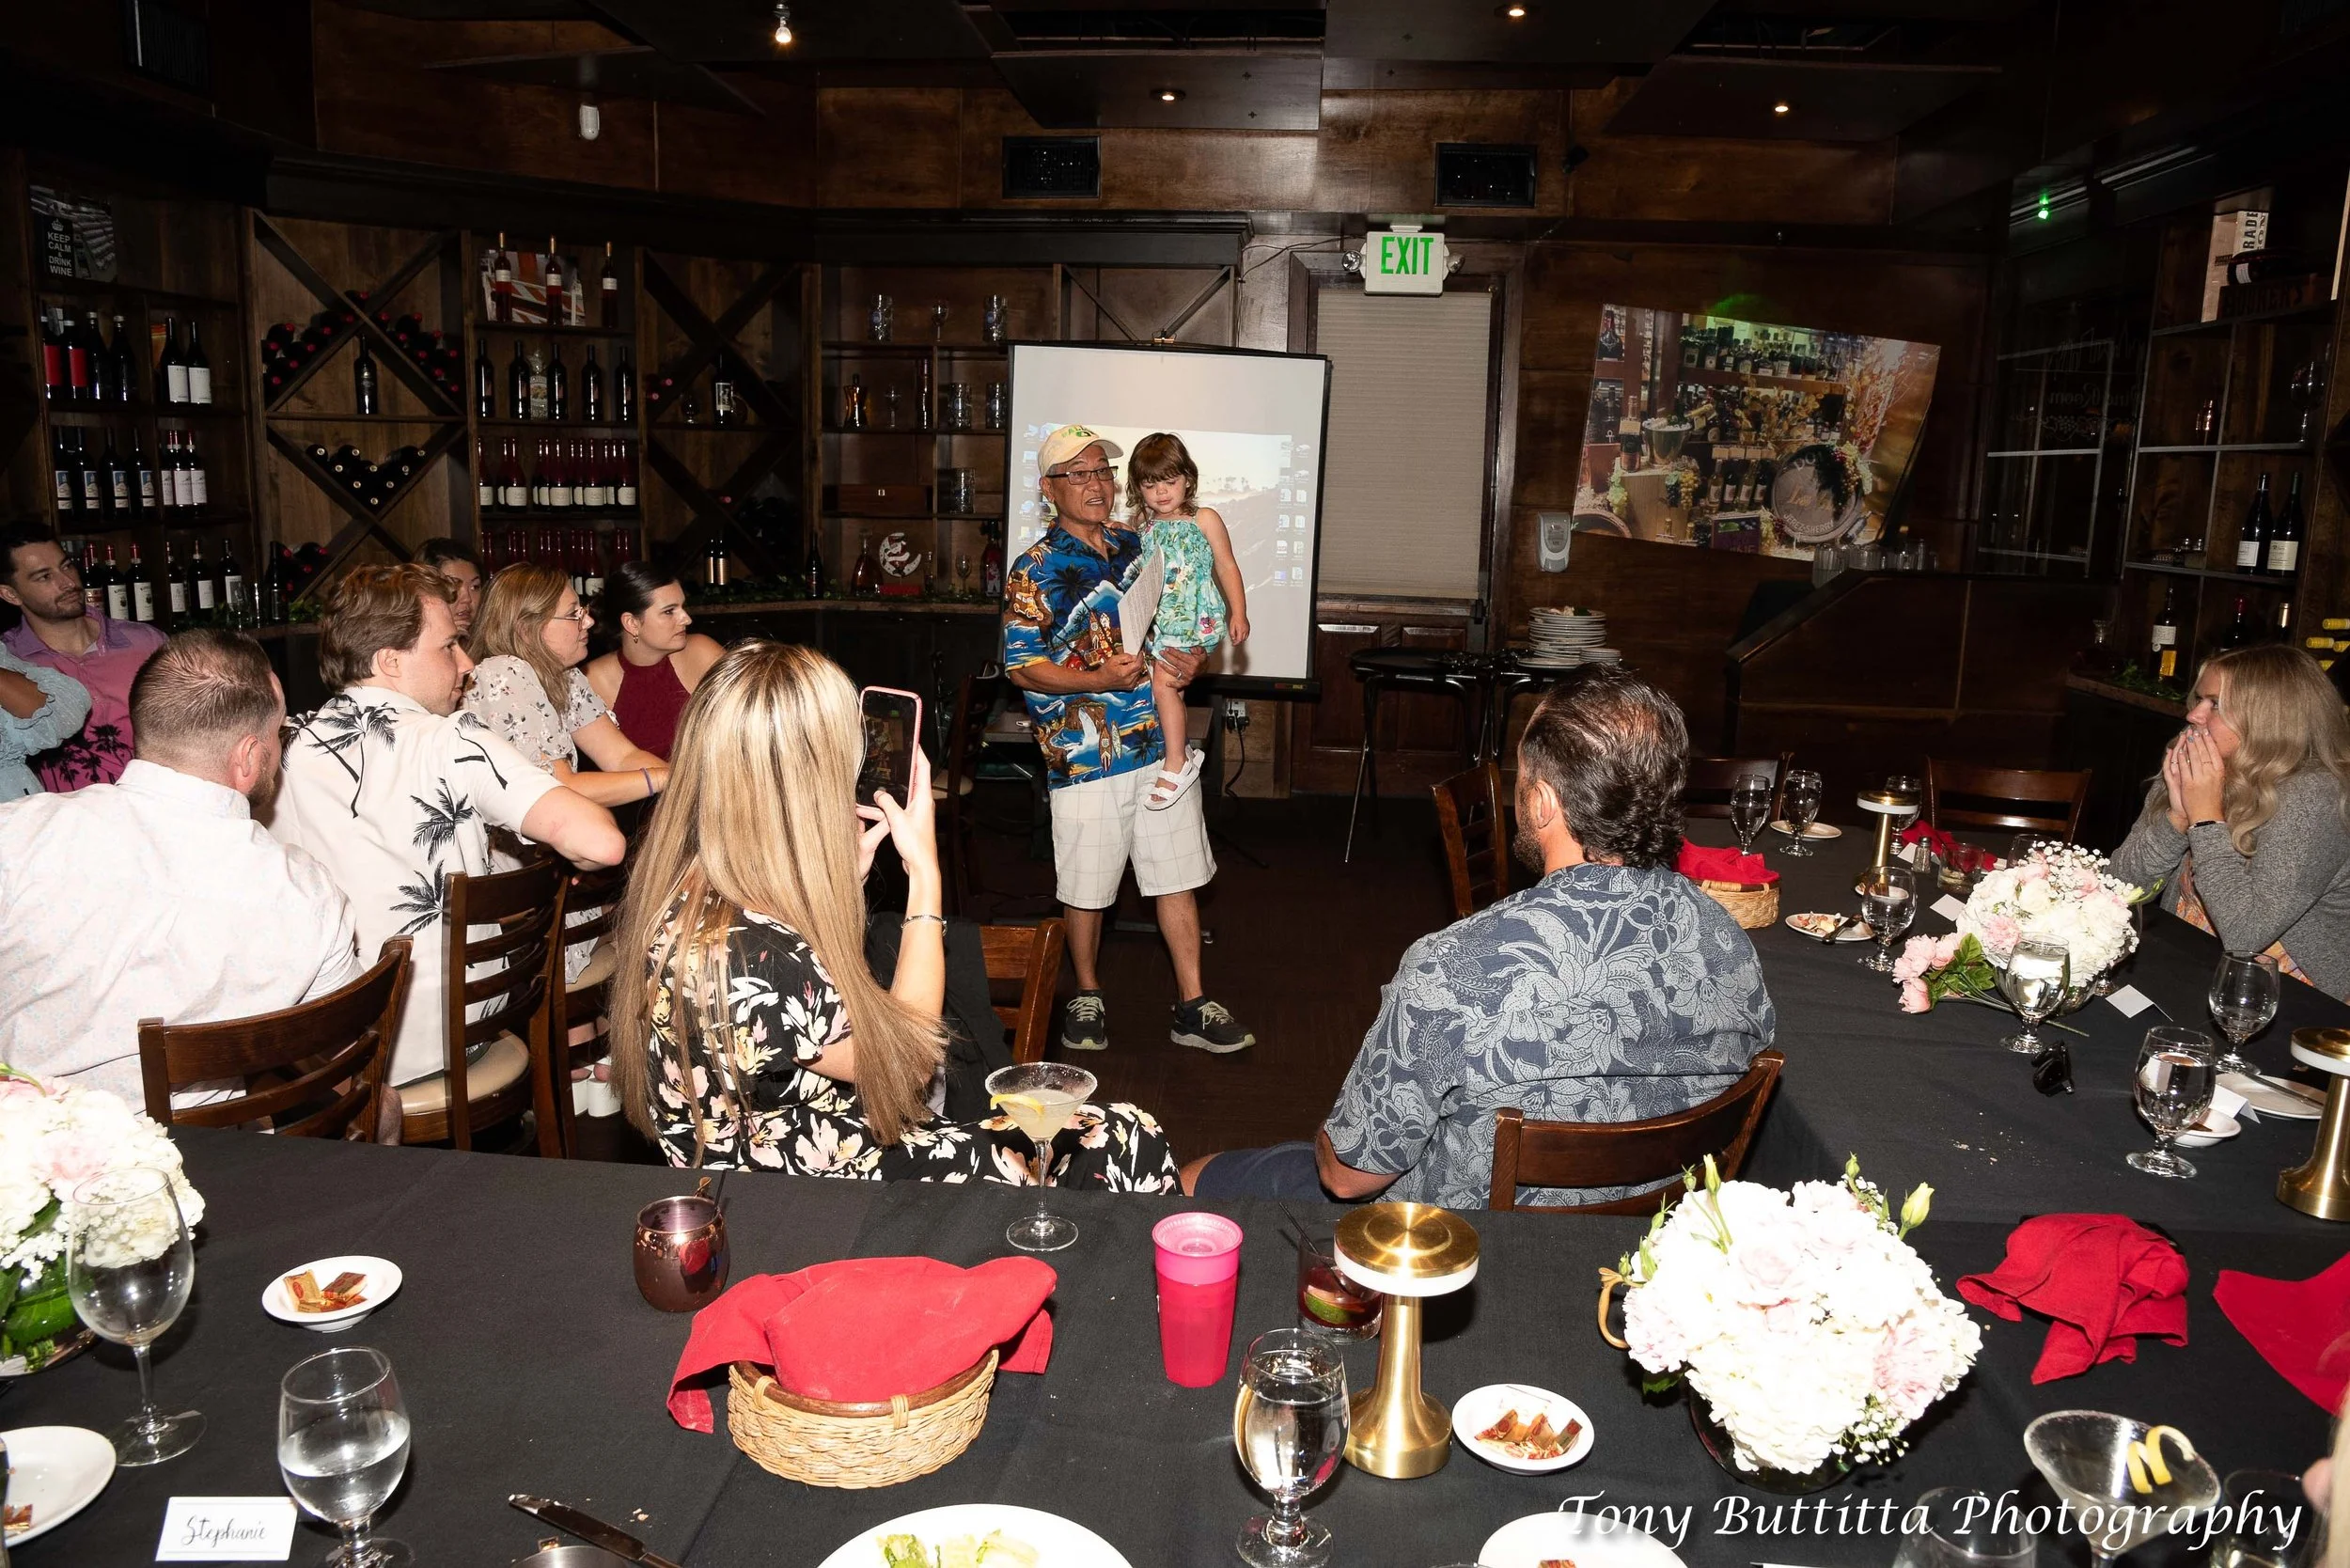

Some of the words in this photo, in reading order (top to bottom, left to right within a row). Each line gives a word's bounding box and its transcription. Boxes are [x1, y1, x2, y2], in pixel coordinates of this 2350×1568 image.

[47, 231, 70, 243] KEEP
[48, 241, 71, 253] CALM
[1381, 236, 1434, 275] EXIT
[48, 256, 72, 268] DRINK
[49, 265, 73, 277] WINE
[181, 1513, 268, 1548] Stephanie
